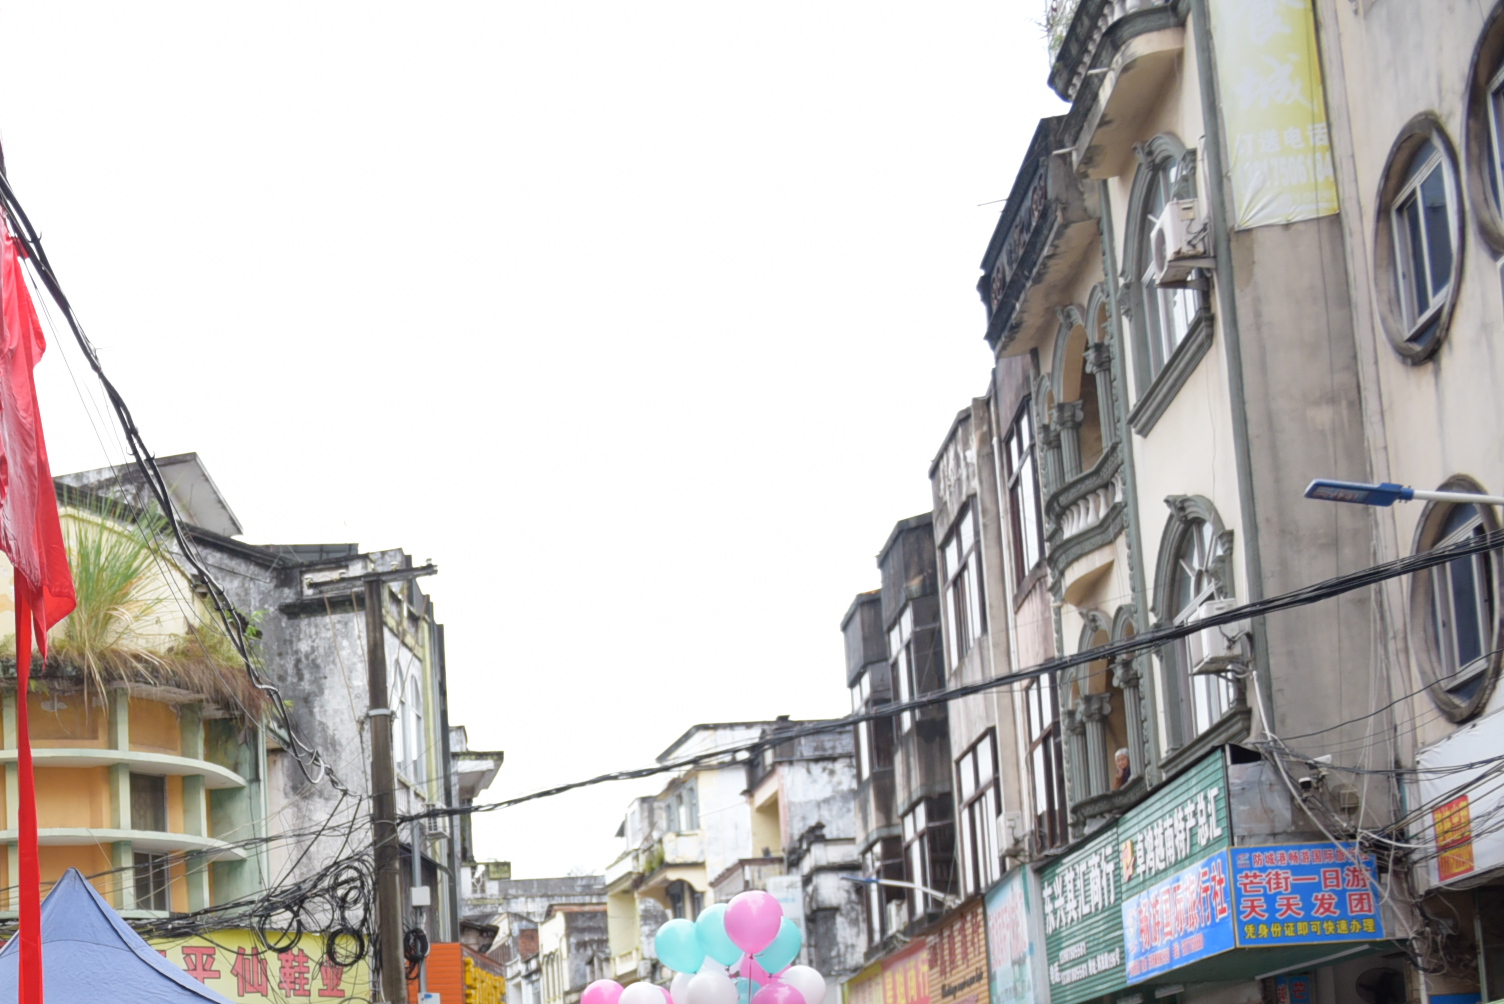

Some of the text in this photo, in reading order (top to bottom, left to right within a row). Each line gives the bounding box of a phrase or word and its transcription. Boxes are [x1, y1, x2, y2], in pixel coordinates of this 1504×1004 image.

[1252, 849, 1370, 867] 防城港畅游国际旅
[1238, 866, 1371, 895] 芒街一日游
[1240, 891, 1375, 921] 天天发团
[1243, 917, 1377, 940] 凭身份证即可快速办理
